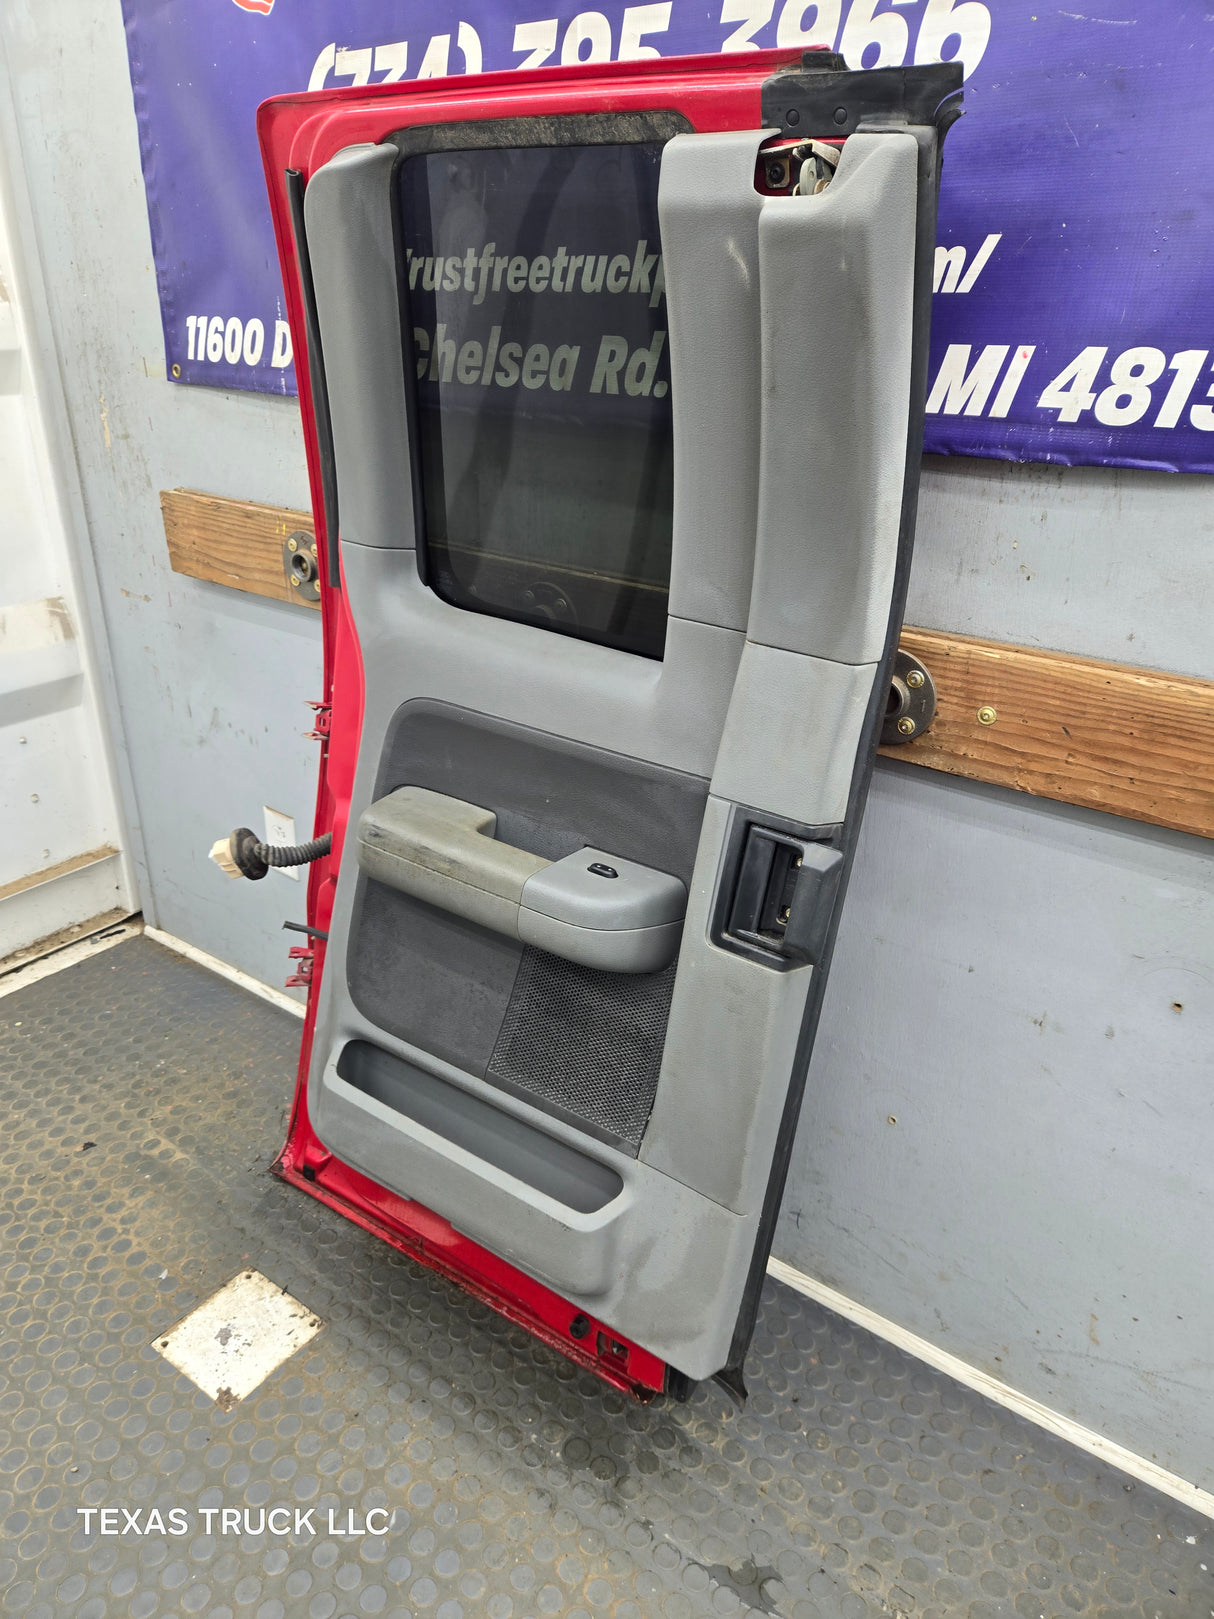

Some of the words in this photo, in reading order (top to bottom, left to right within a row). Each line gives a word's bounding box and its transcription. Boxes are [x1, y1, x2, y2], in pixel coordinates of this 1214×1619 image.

[407, 240, 668, 307] rustfreetruck
[186, 315, 265, 367] 11600
[589, 331, 668, 398] Rd.
[925, 344, 1036, 418] MI
